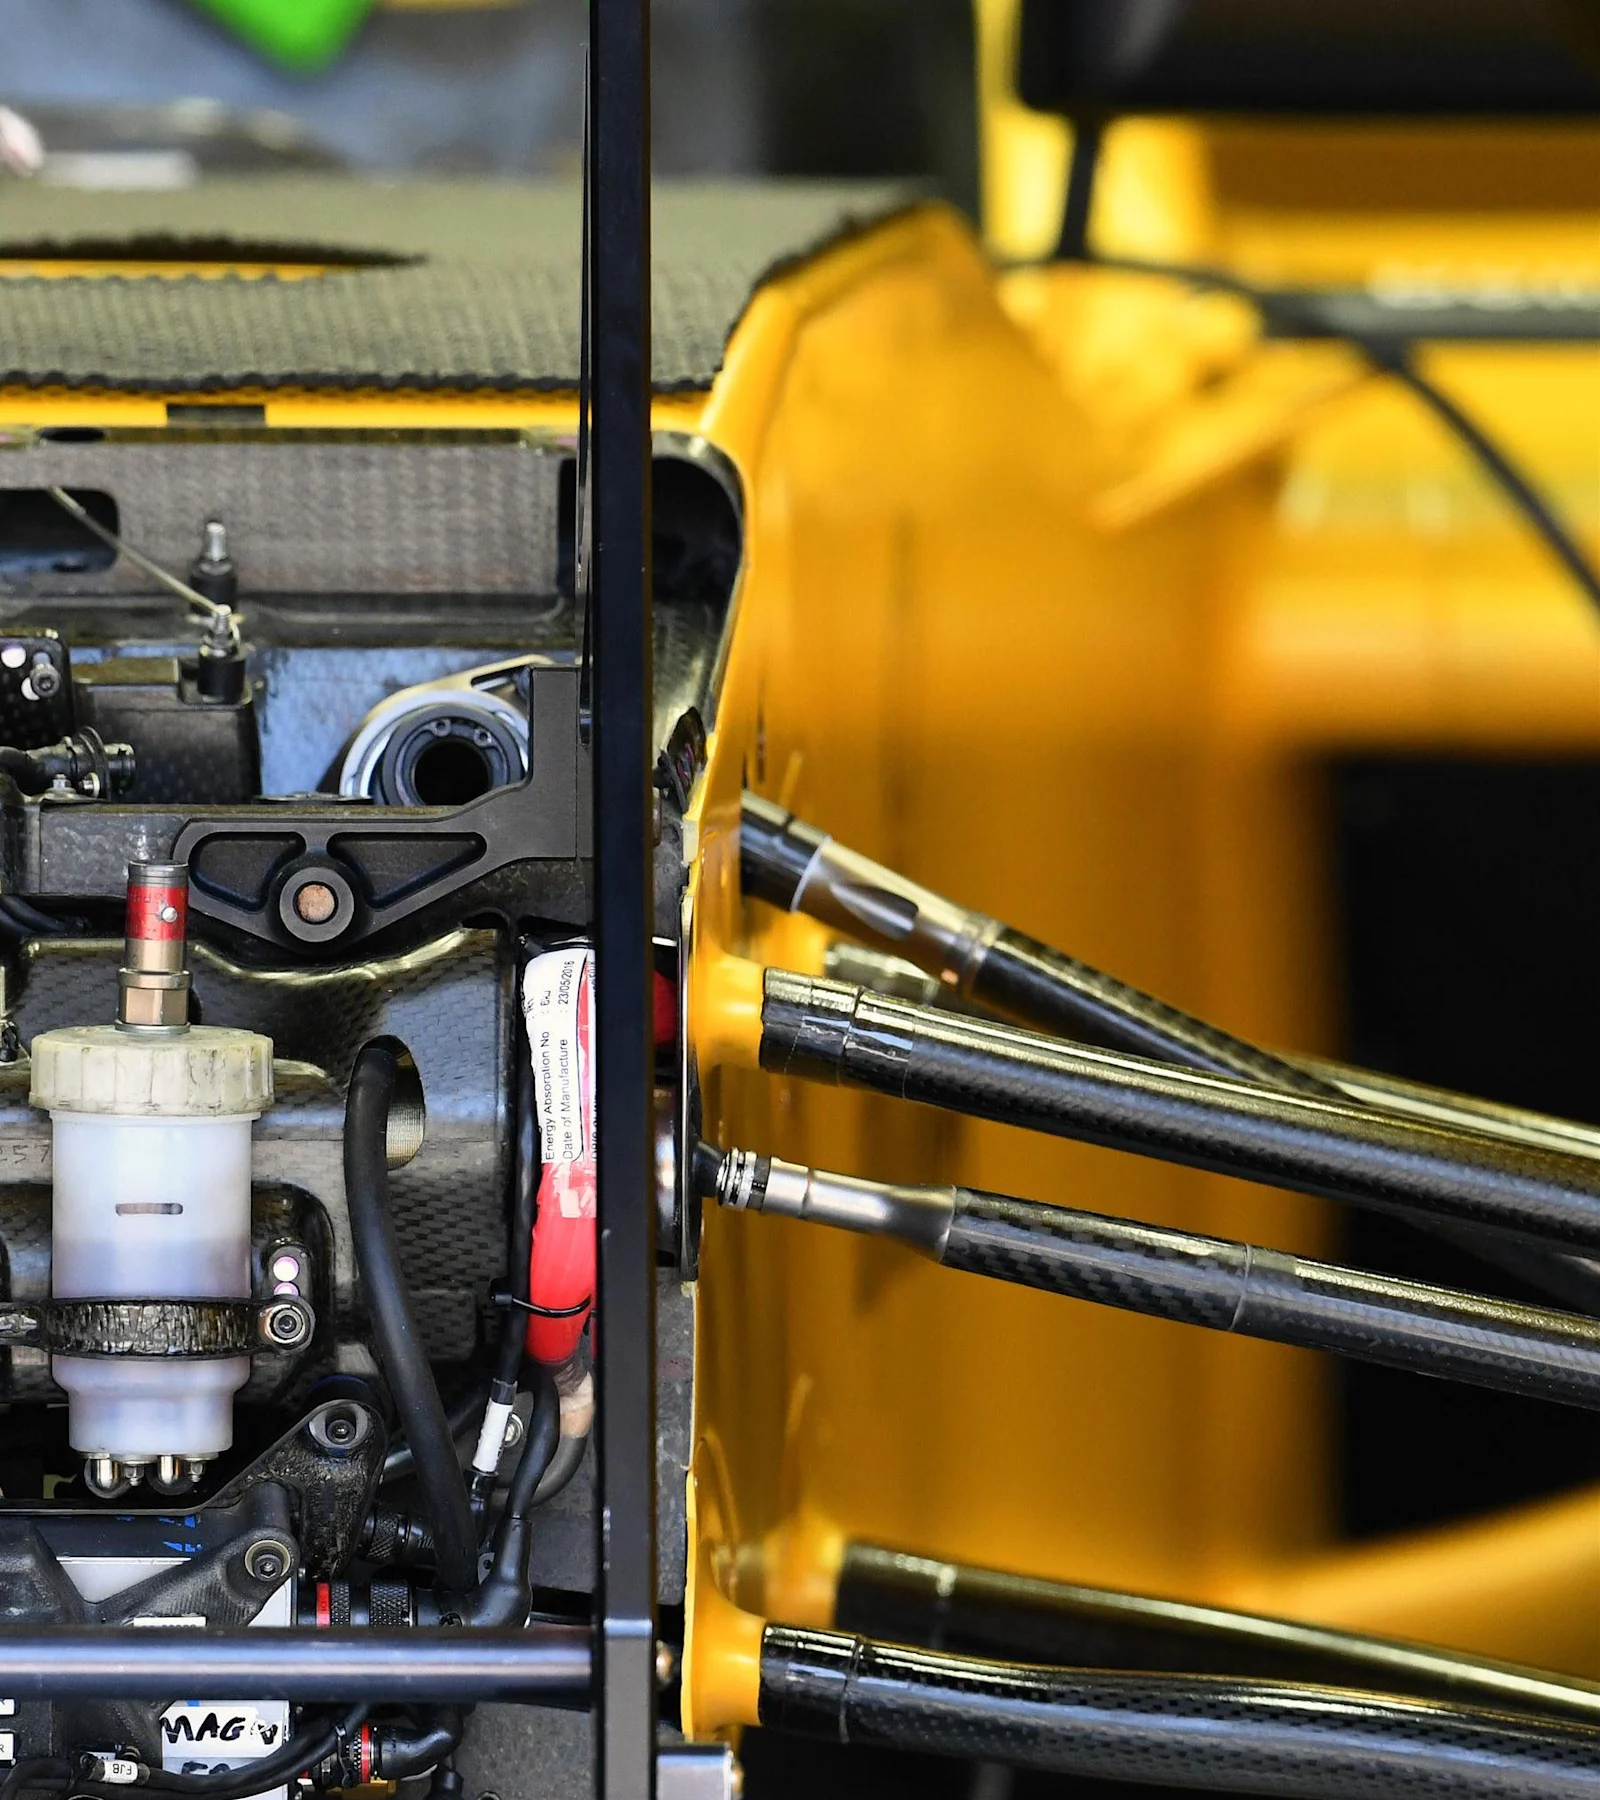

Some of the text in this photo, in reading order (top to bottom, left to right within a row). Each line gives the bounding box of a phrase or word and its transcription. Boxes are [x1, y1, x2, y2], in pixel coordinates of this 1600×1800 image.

[540, 1032, 550, 1047] No
[558, 961, 575, 1159] Date of Manufacture 23/05/2016
[541, 1051, 553, 1114] Absorption
[545, 1118, 556, 1160] Energy
